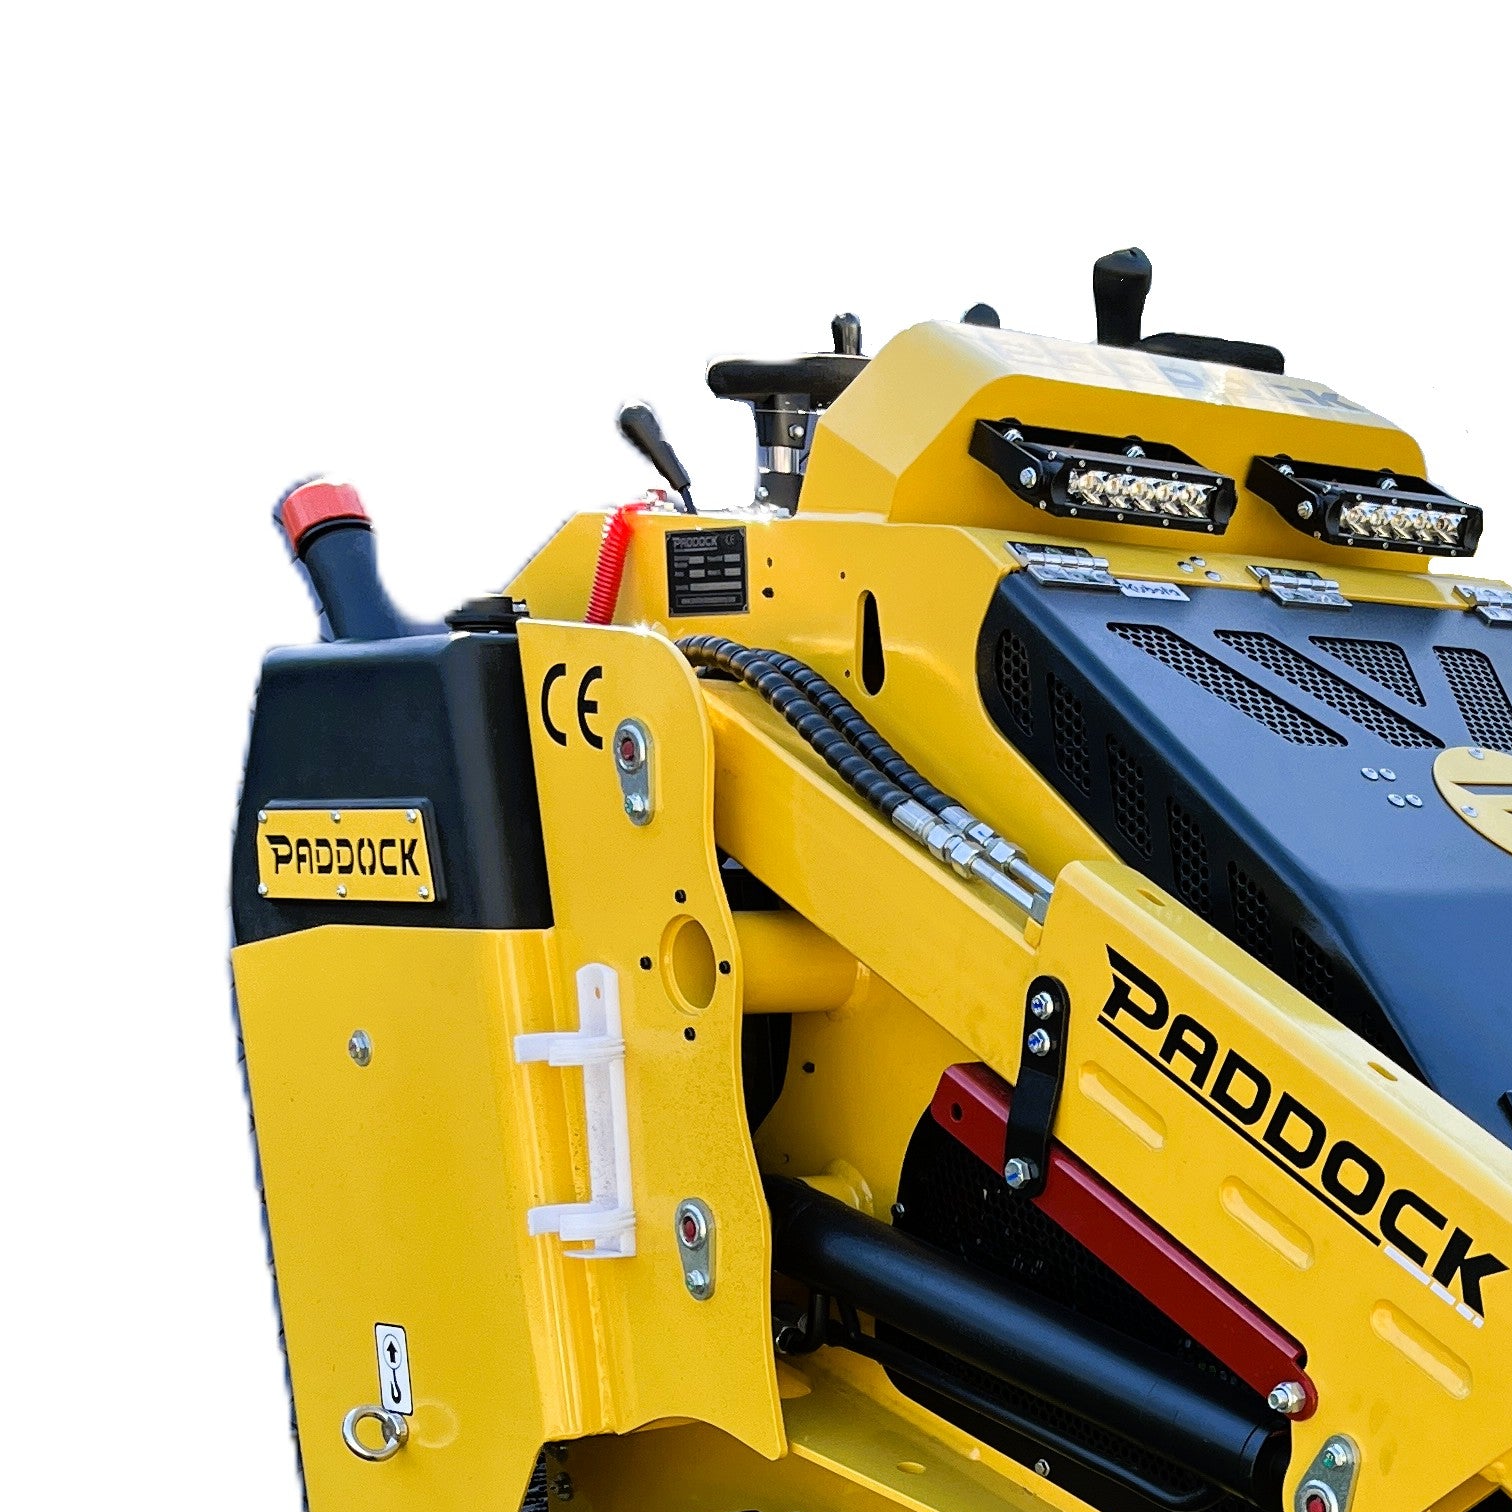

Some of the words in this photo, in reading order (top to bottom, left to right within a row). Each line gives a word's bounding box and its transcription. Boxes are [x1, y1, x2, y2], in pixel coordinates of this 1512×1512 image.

[541, 663, 603, 749] CE
[265, 834, 420, 876] PADDOCK
[1102, 944, 1509, 1319] PADDOCK
